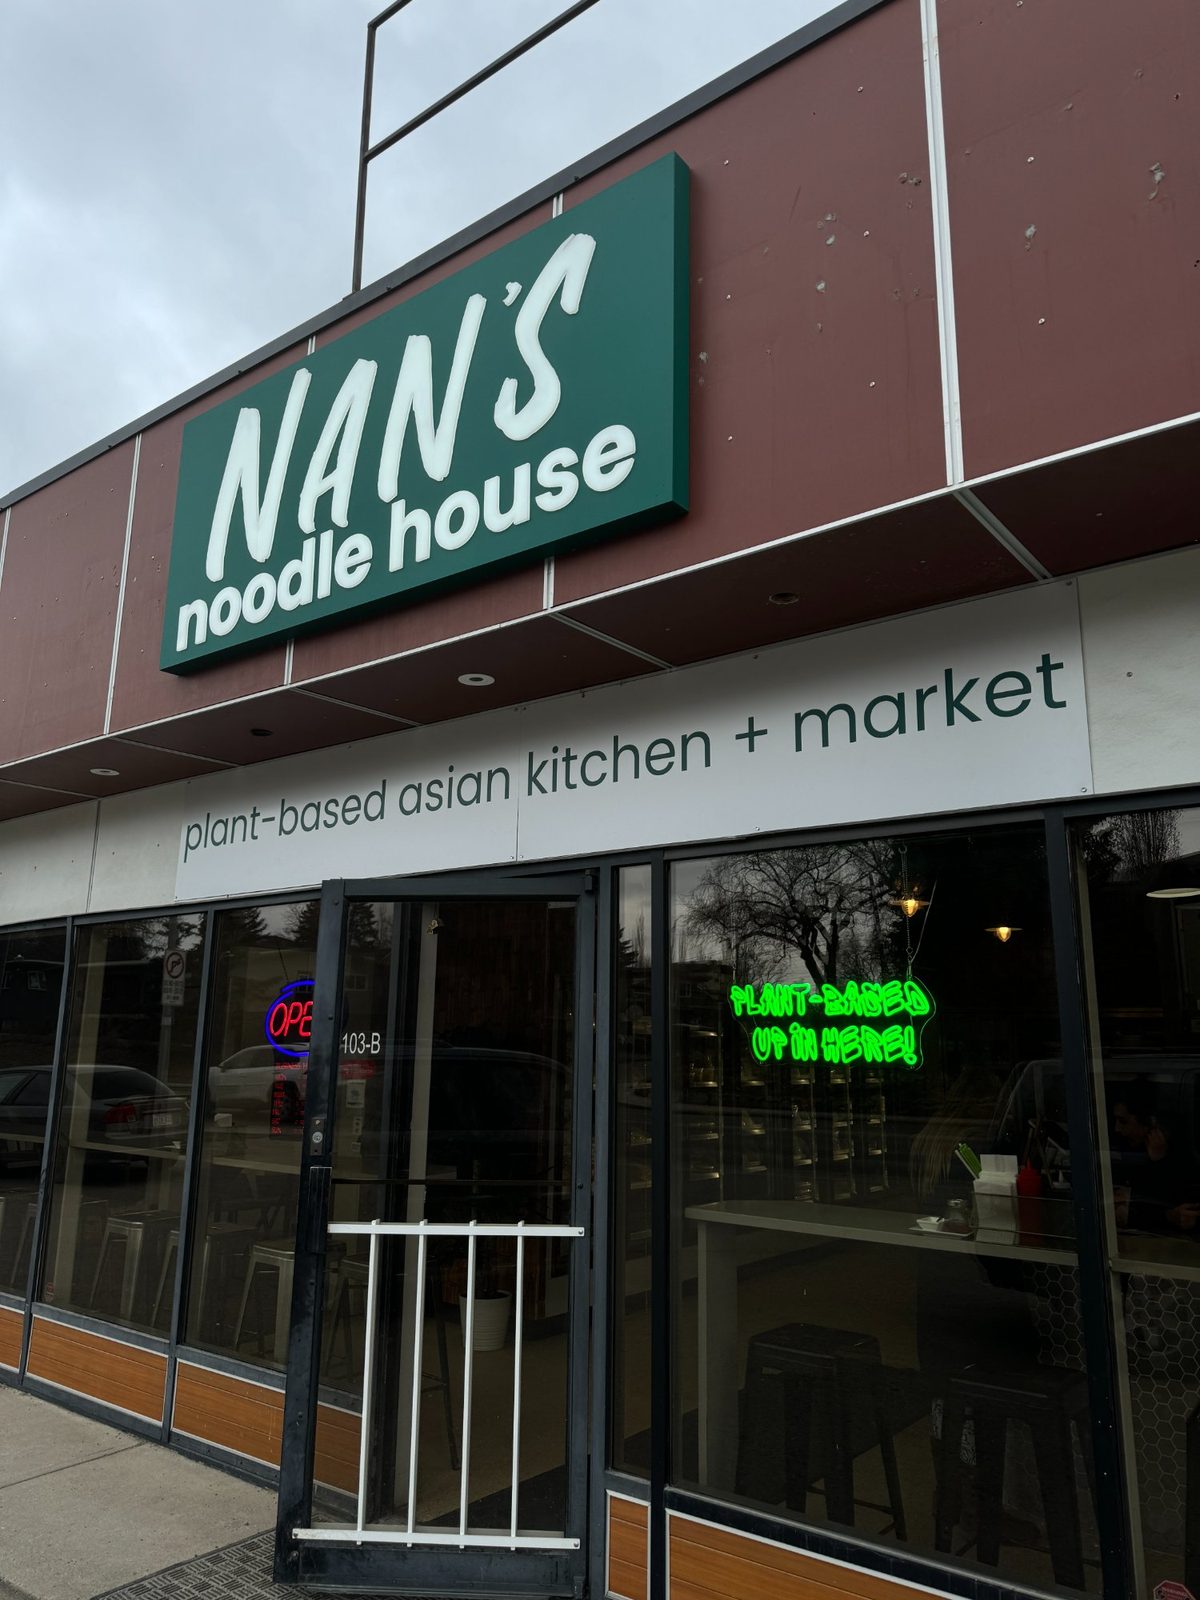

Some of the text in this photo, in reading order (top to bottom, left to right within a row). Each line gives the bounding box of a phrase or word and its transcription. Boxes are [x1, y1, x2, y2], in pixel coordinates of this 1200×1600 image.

[205, 232, 598, 583] NAN'S
[175, 423, 638, 653] noodle house
[183, 652, 1068, 863] plant-based asian kitchen + market
[270, 1001, 314, 1037] OPE
[730, 980, 931, 1018] PLANT-BASED
[342, 1032, 381, 1055] 103-B
[752, 1025, 788, 1061] UP
[820, 1024, 918, 1066] HERE!
